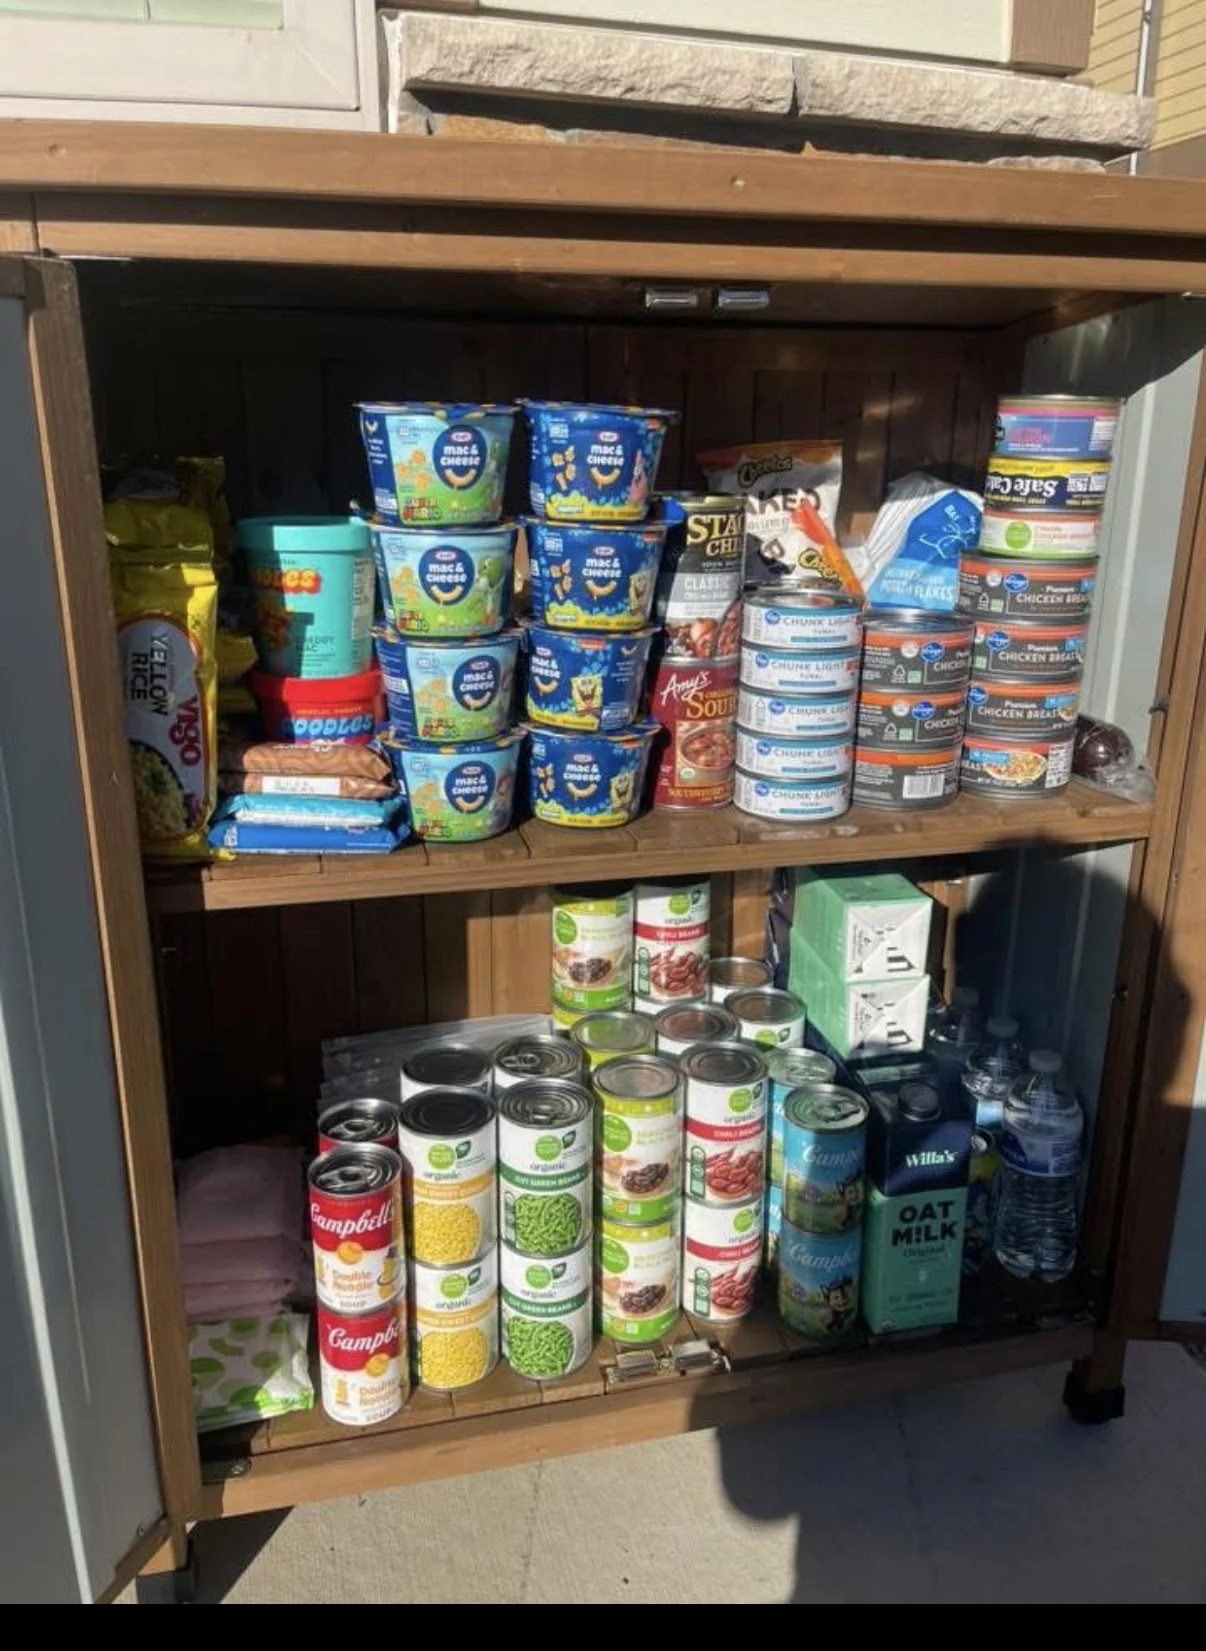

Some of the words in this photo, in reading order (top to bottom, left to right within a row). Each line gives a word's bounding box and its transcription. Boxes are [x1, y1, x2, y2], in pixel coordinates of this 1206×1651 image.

[1013, 476, 1059, 498] Safe
[1016, 593, 1064, 604] CHICKEN
[783, 616, 825, 626] CHUNK
[998, 651, 1046, 663] CHICKEN
[771, 661, 812, 672] CHUNK
[131, 651, 149, 701] RICE
[149, 635, 169, 716] YELLOW
[660, 670, 712, 706] Amy's
[788, 706, 827, 715] CHUNK
[978, 707, 1025, 719] CHICKEN
[774, 749, 815, 758] CHUNK
[772, 791, 812, 800] CHUNK
[906, 1149, 957, 1168] Willa's
[529, 1162, 566, 1172] organic
[530, 1178, 557, 1187] GREEN
[899, 1201, 955, 1224] OAT
[332, 1270, 373, 1280] Double
[332, 1281, 374, 1291] Noodle
